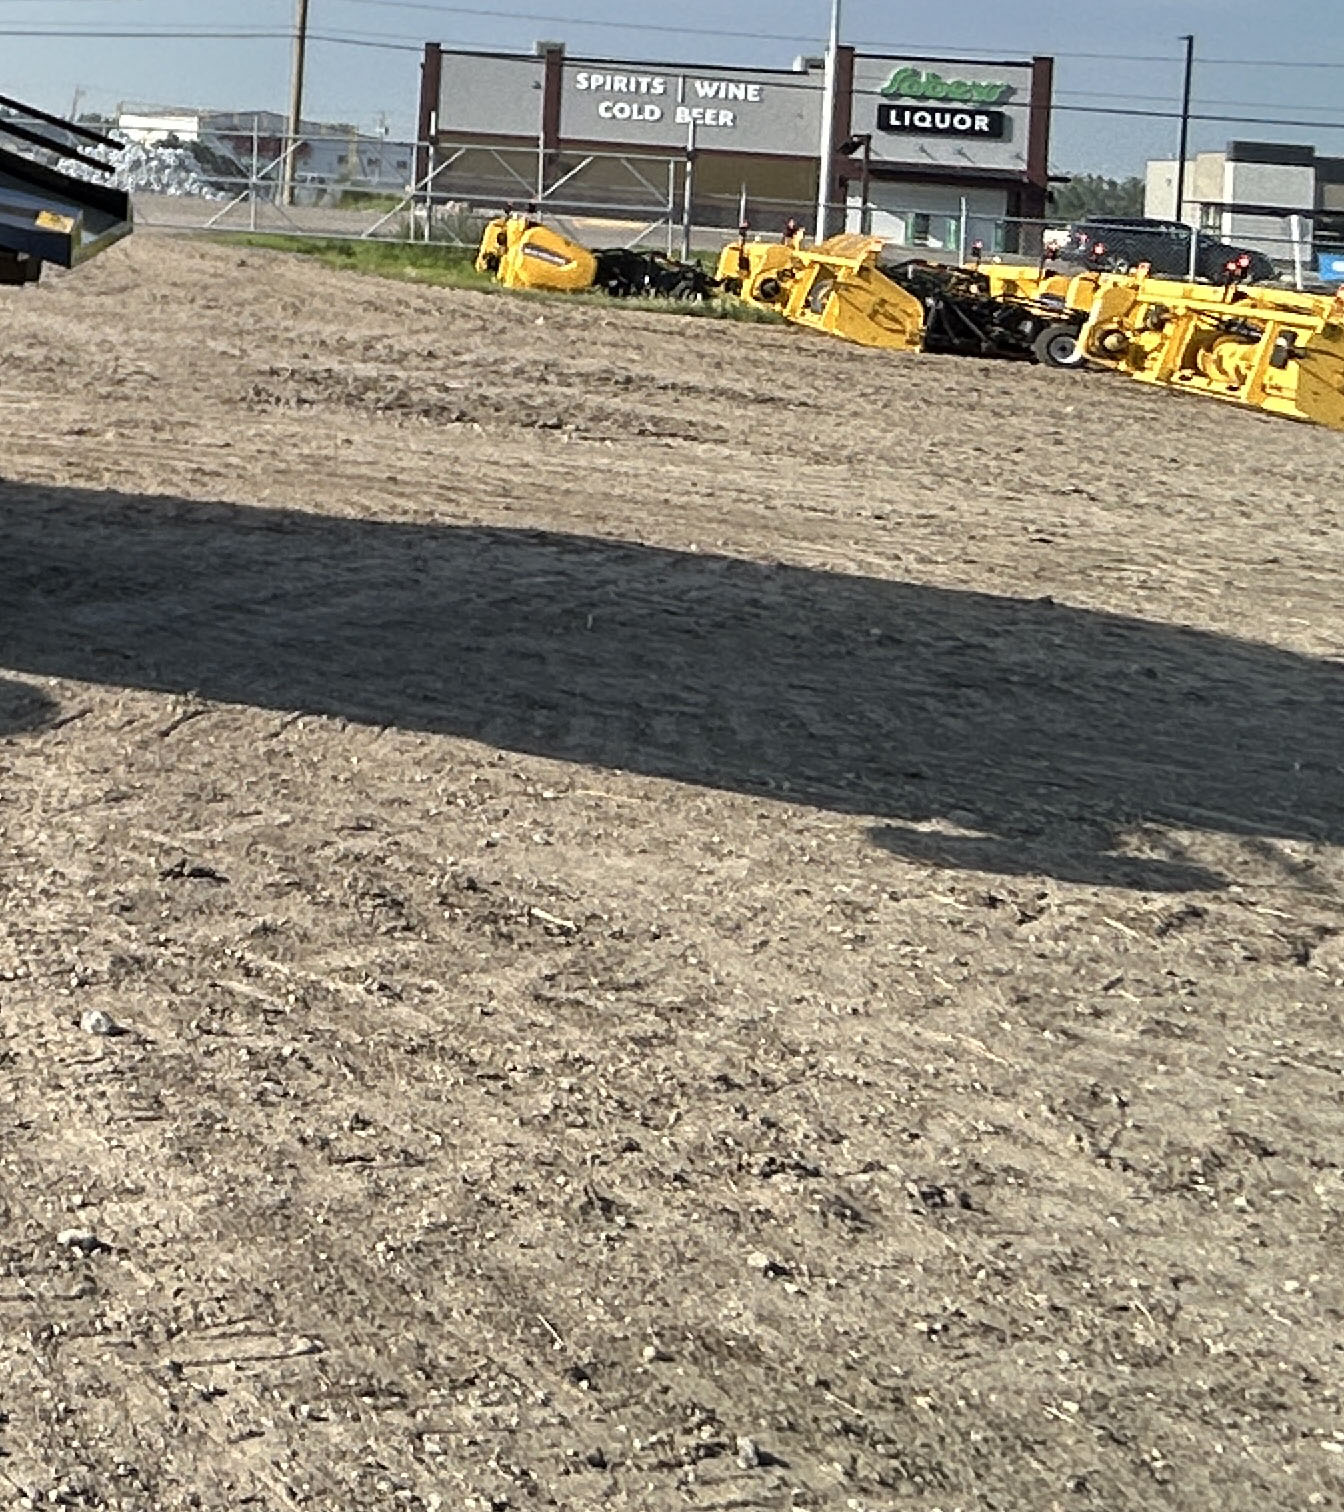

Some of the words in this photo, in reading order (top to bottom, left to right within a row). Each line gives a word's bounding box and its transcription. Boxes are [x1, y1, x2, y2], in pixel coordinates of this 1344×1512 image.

[575, 72, 666, 94] SPIRITS
[694, 79, 762, 102] WINE
[598, 100, 662, 121] COLD
[674, 106, 735, 127] BEER
[888, 108, 991, 132] LIQUOR
